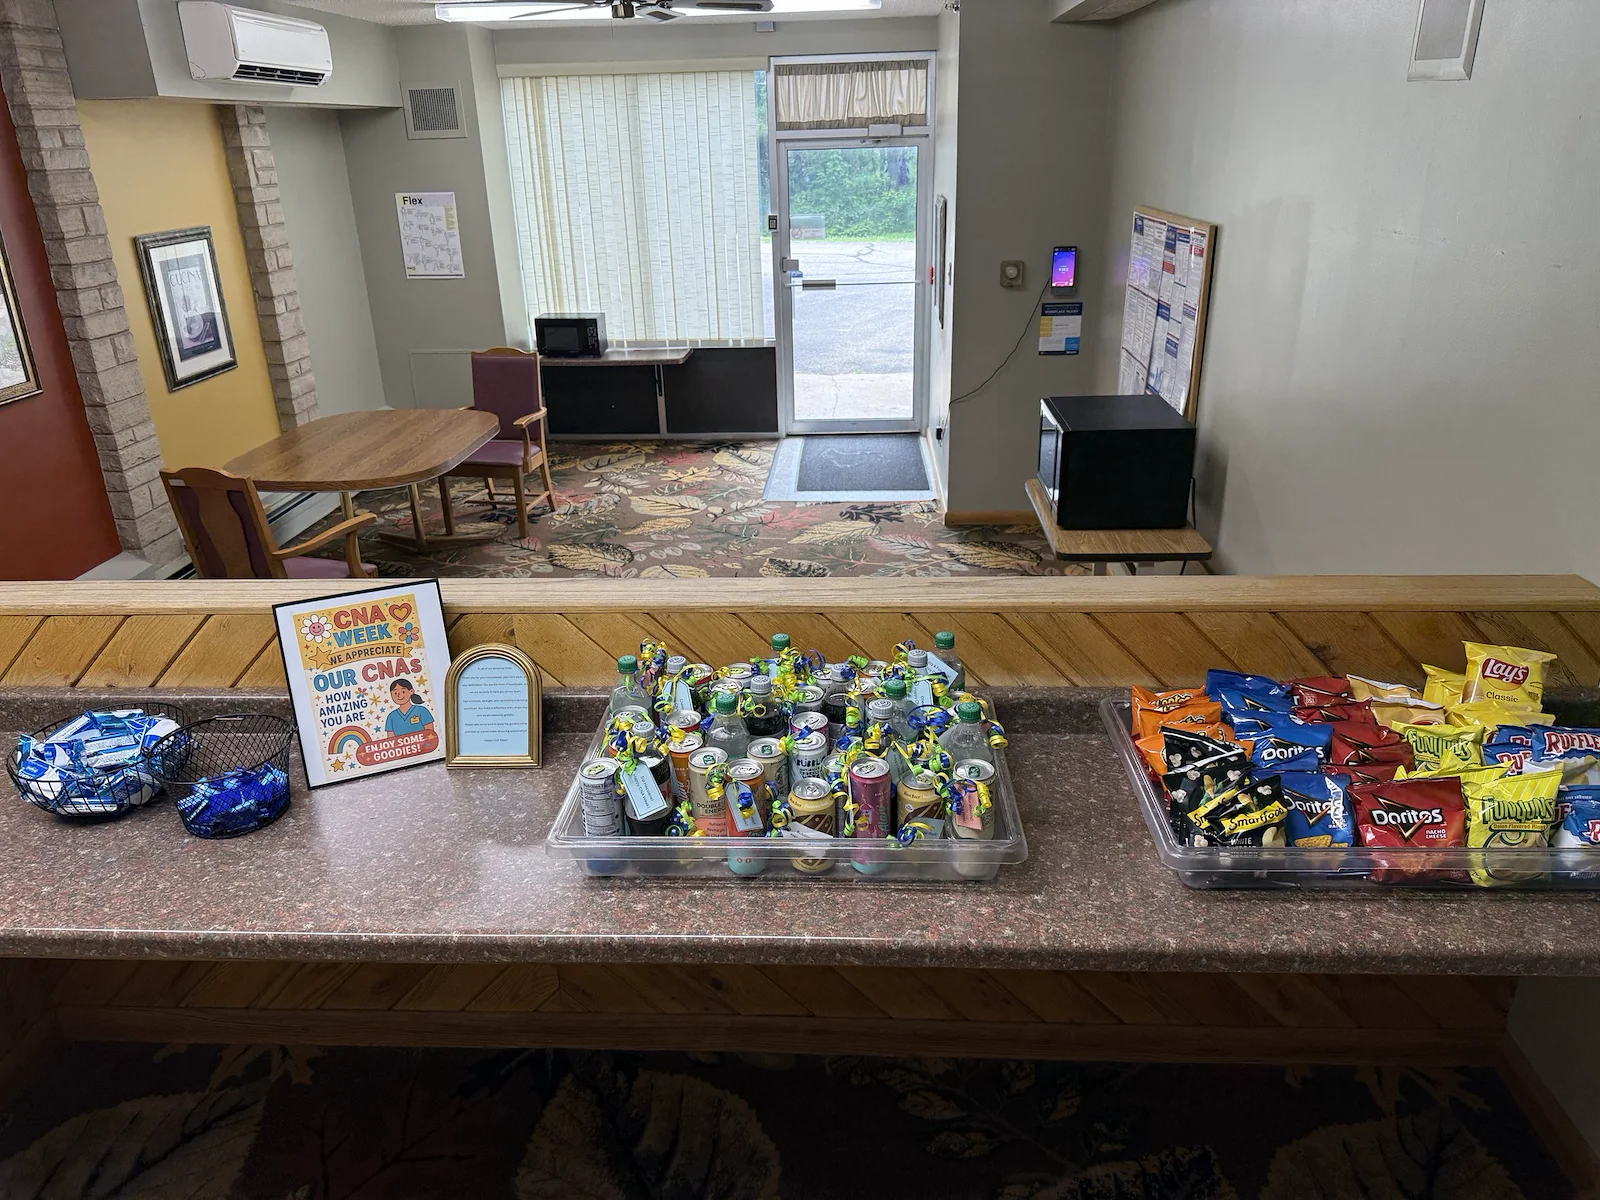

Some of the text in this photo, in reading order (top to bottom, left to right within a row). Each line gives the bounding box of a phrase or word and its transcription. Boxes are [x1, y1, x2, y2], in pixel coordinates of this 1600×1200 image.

[402, 196, 423, 205] Flex
[333, 604, 387, 629] CNA
[333, 622, 393, 648] WEEK
[345, 645, 402, 661] APPRECIATE
[313, 668, 358, 692] OUR
[1484, 658, 1528, 683] Lay's
[325, 690, 352, 704] HOW
[1486, 691, 1519, 703] Classic
[319, 699, 369, 718] AMAZING
[320, 711, 366, 728] YOU ARE
[364, 733, 425, 753] ENJOY SOME
[1545, 732, 1600, 754] RUFFLE
[373, 745, 421, 761] GOODIES!
[1261, 746, 1325, 761] Dorits
[1284, 795, 1343, 814] Dorito
[1228, 805, 1285, 831] Smartfood
[1371, 808, 1443, 825] Doritos
